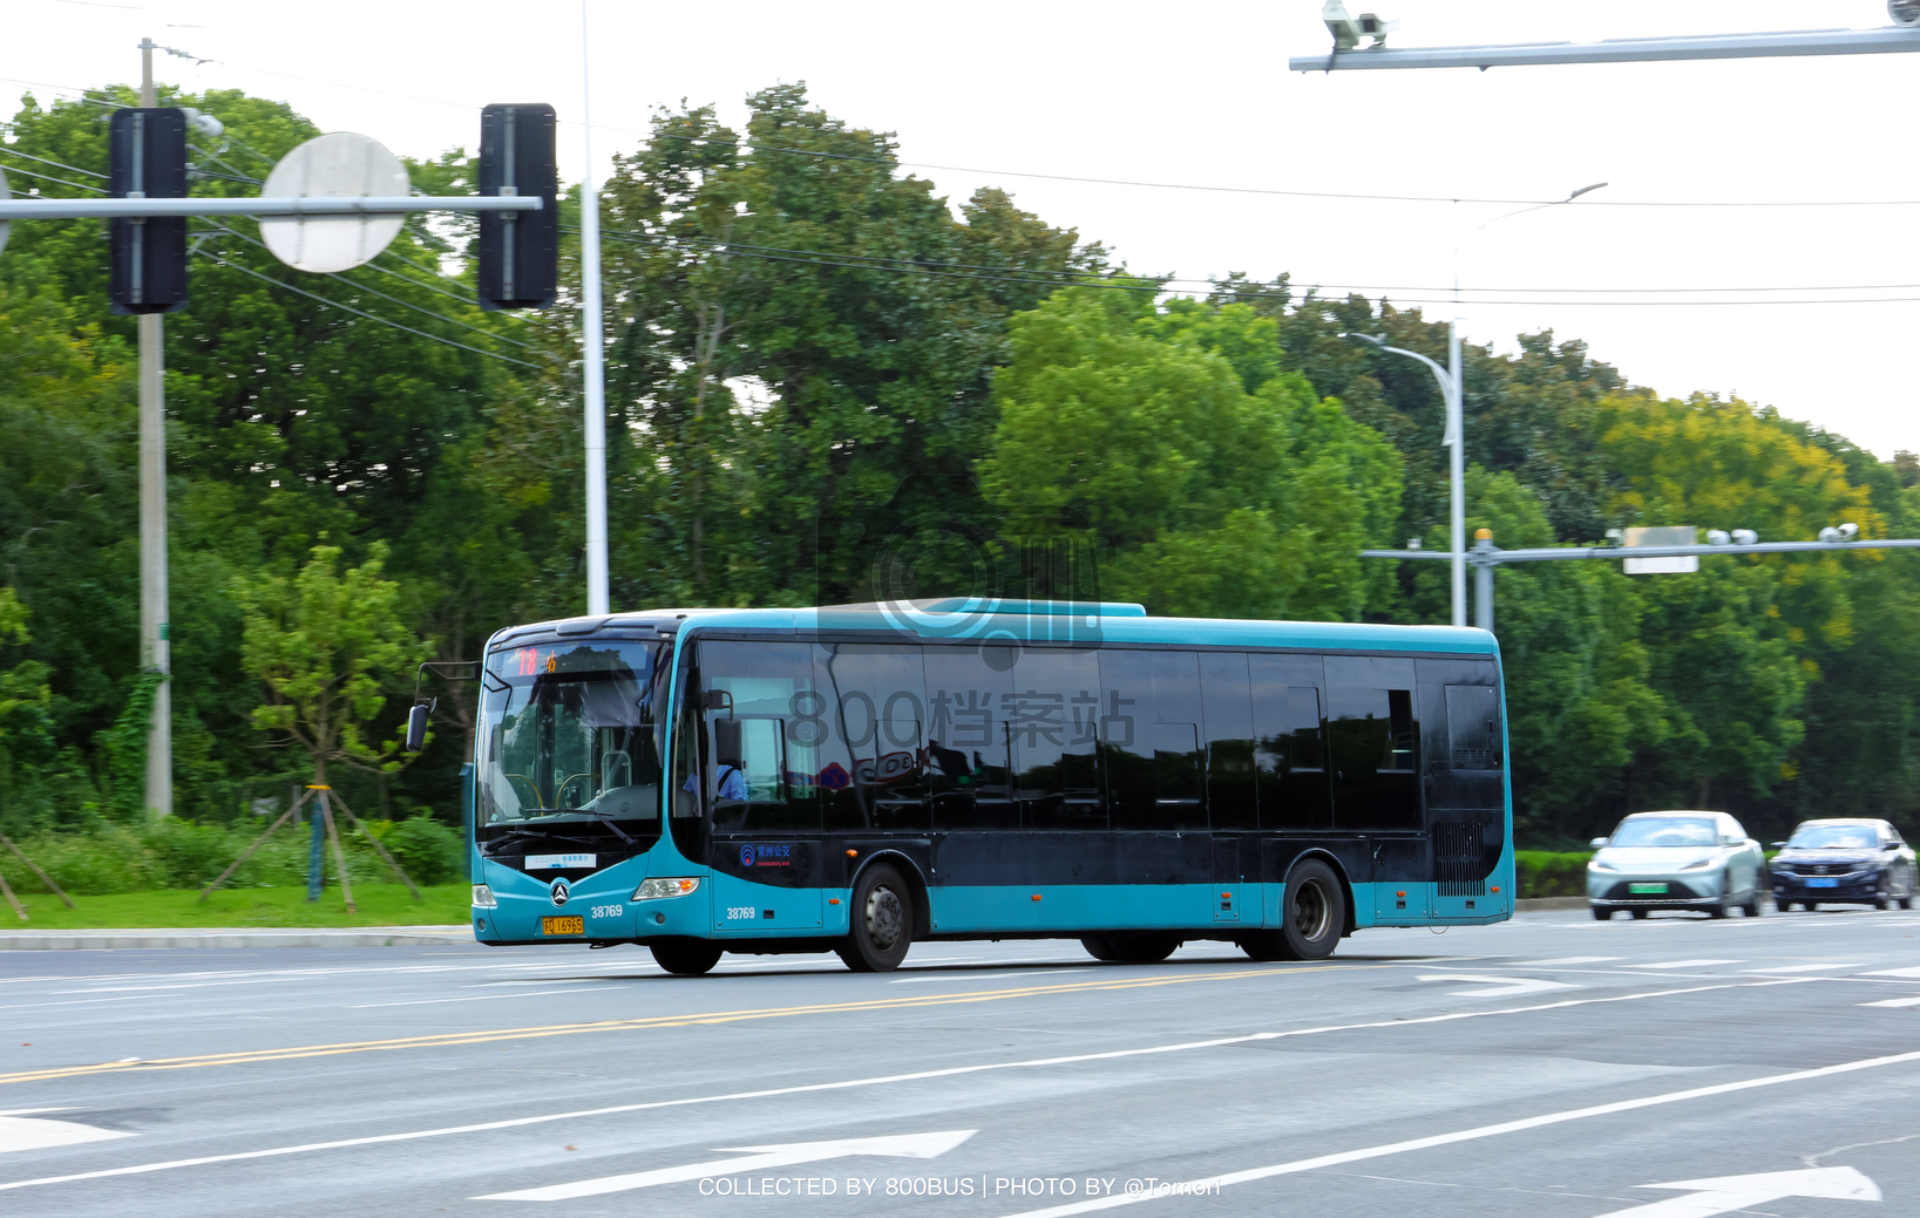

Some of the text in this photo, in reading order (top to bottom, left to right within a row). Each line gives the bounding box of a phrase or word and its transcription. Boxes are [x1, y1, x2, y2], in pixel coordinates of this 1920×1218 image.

[519, 648, 537, 676] 18
[590, 904, 623, 919] 38769
[727, 907, 755, 920] 38769
